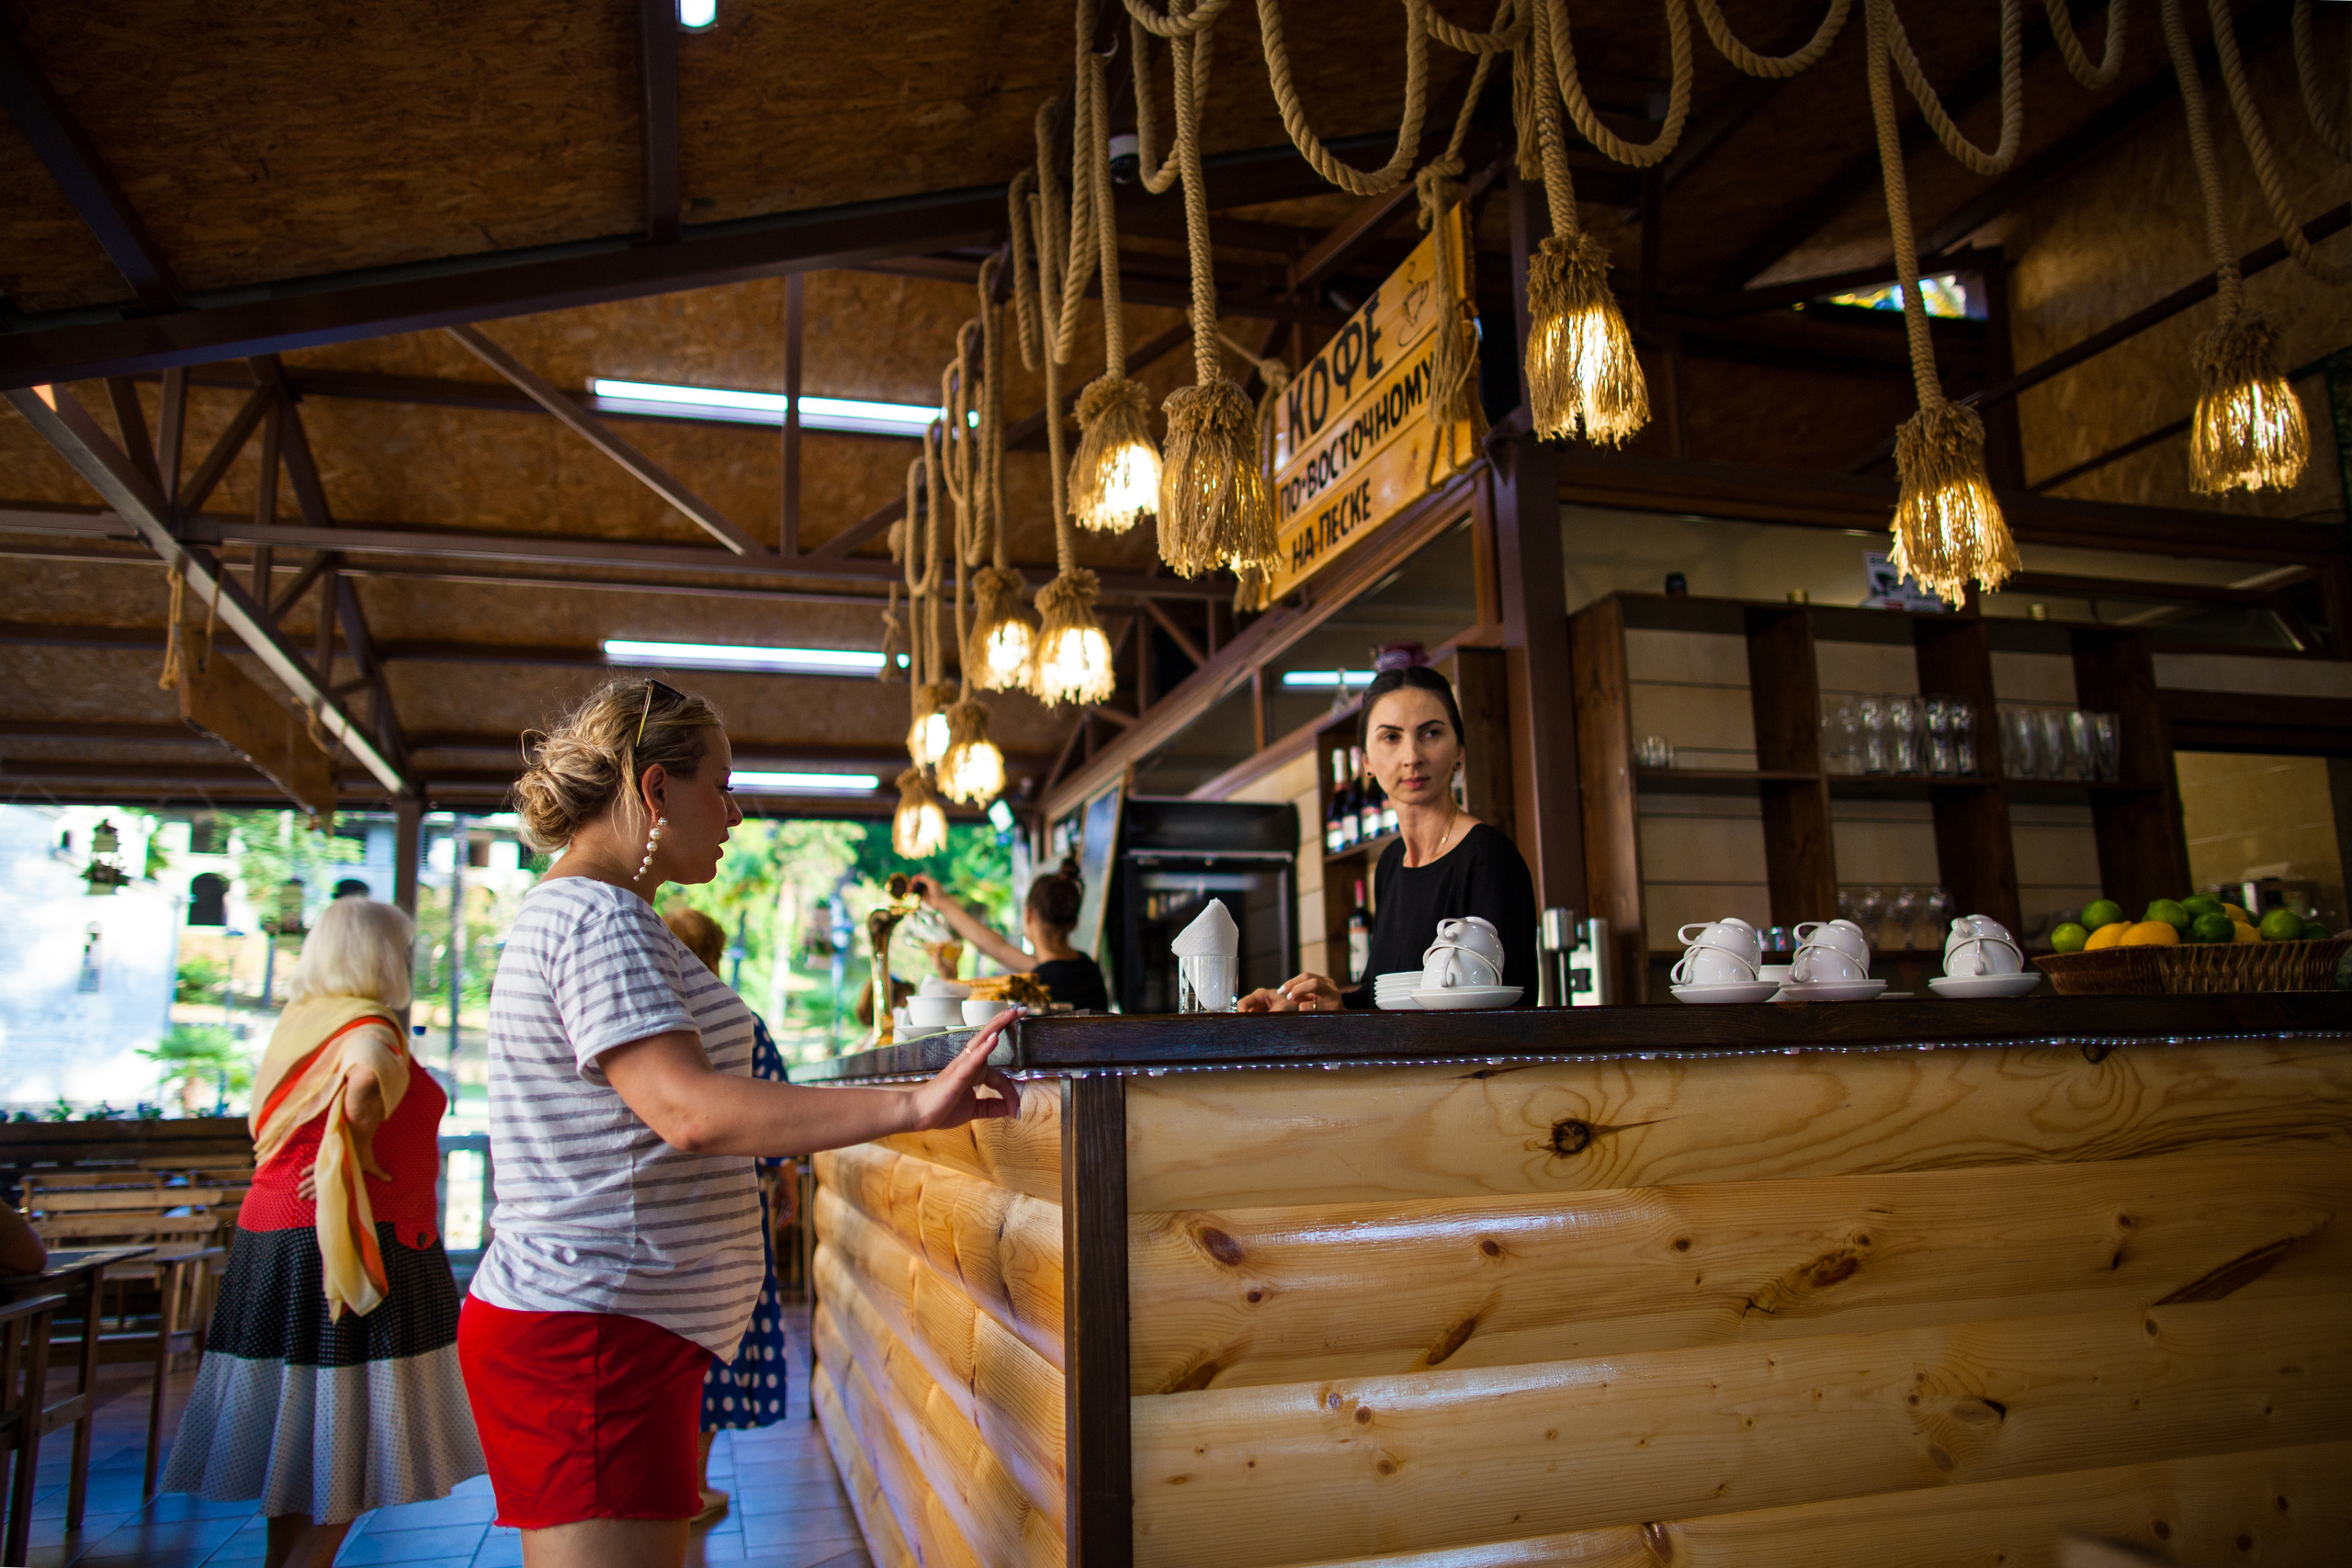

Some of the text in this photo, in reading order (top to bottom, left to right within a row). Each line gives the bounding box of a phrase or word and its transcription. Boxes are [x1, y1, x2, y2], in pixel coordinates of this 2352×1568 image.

[1288, 291, 1383, 455] КОФЕ
[1292, 478, 1371, 574] НА ПЕСКЕ
